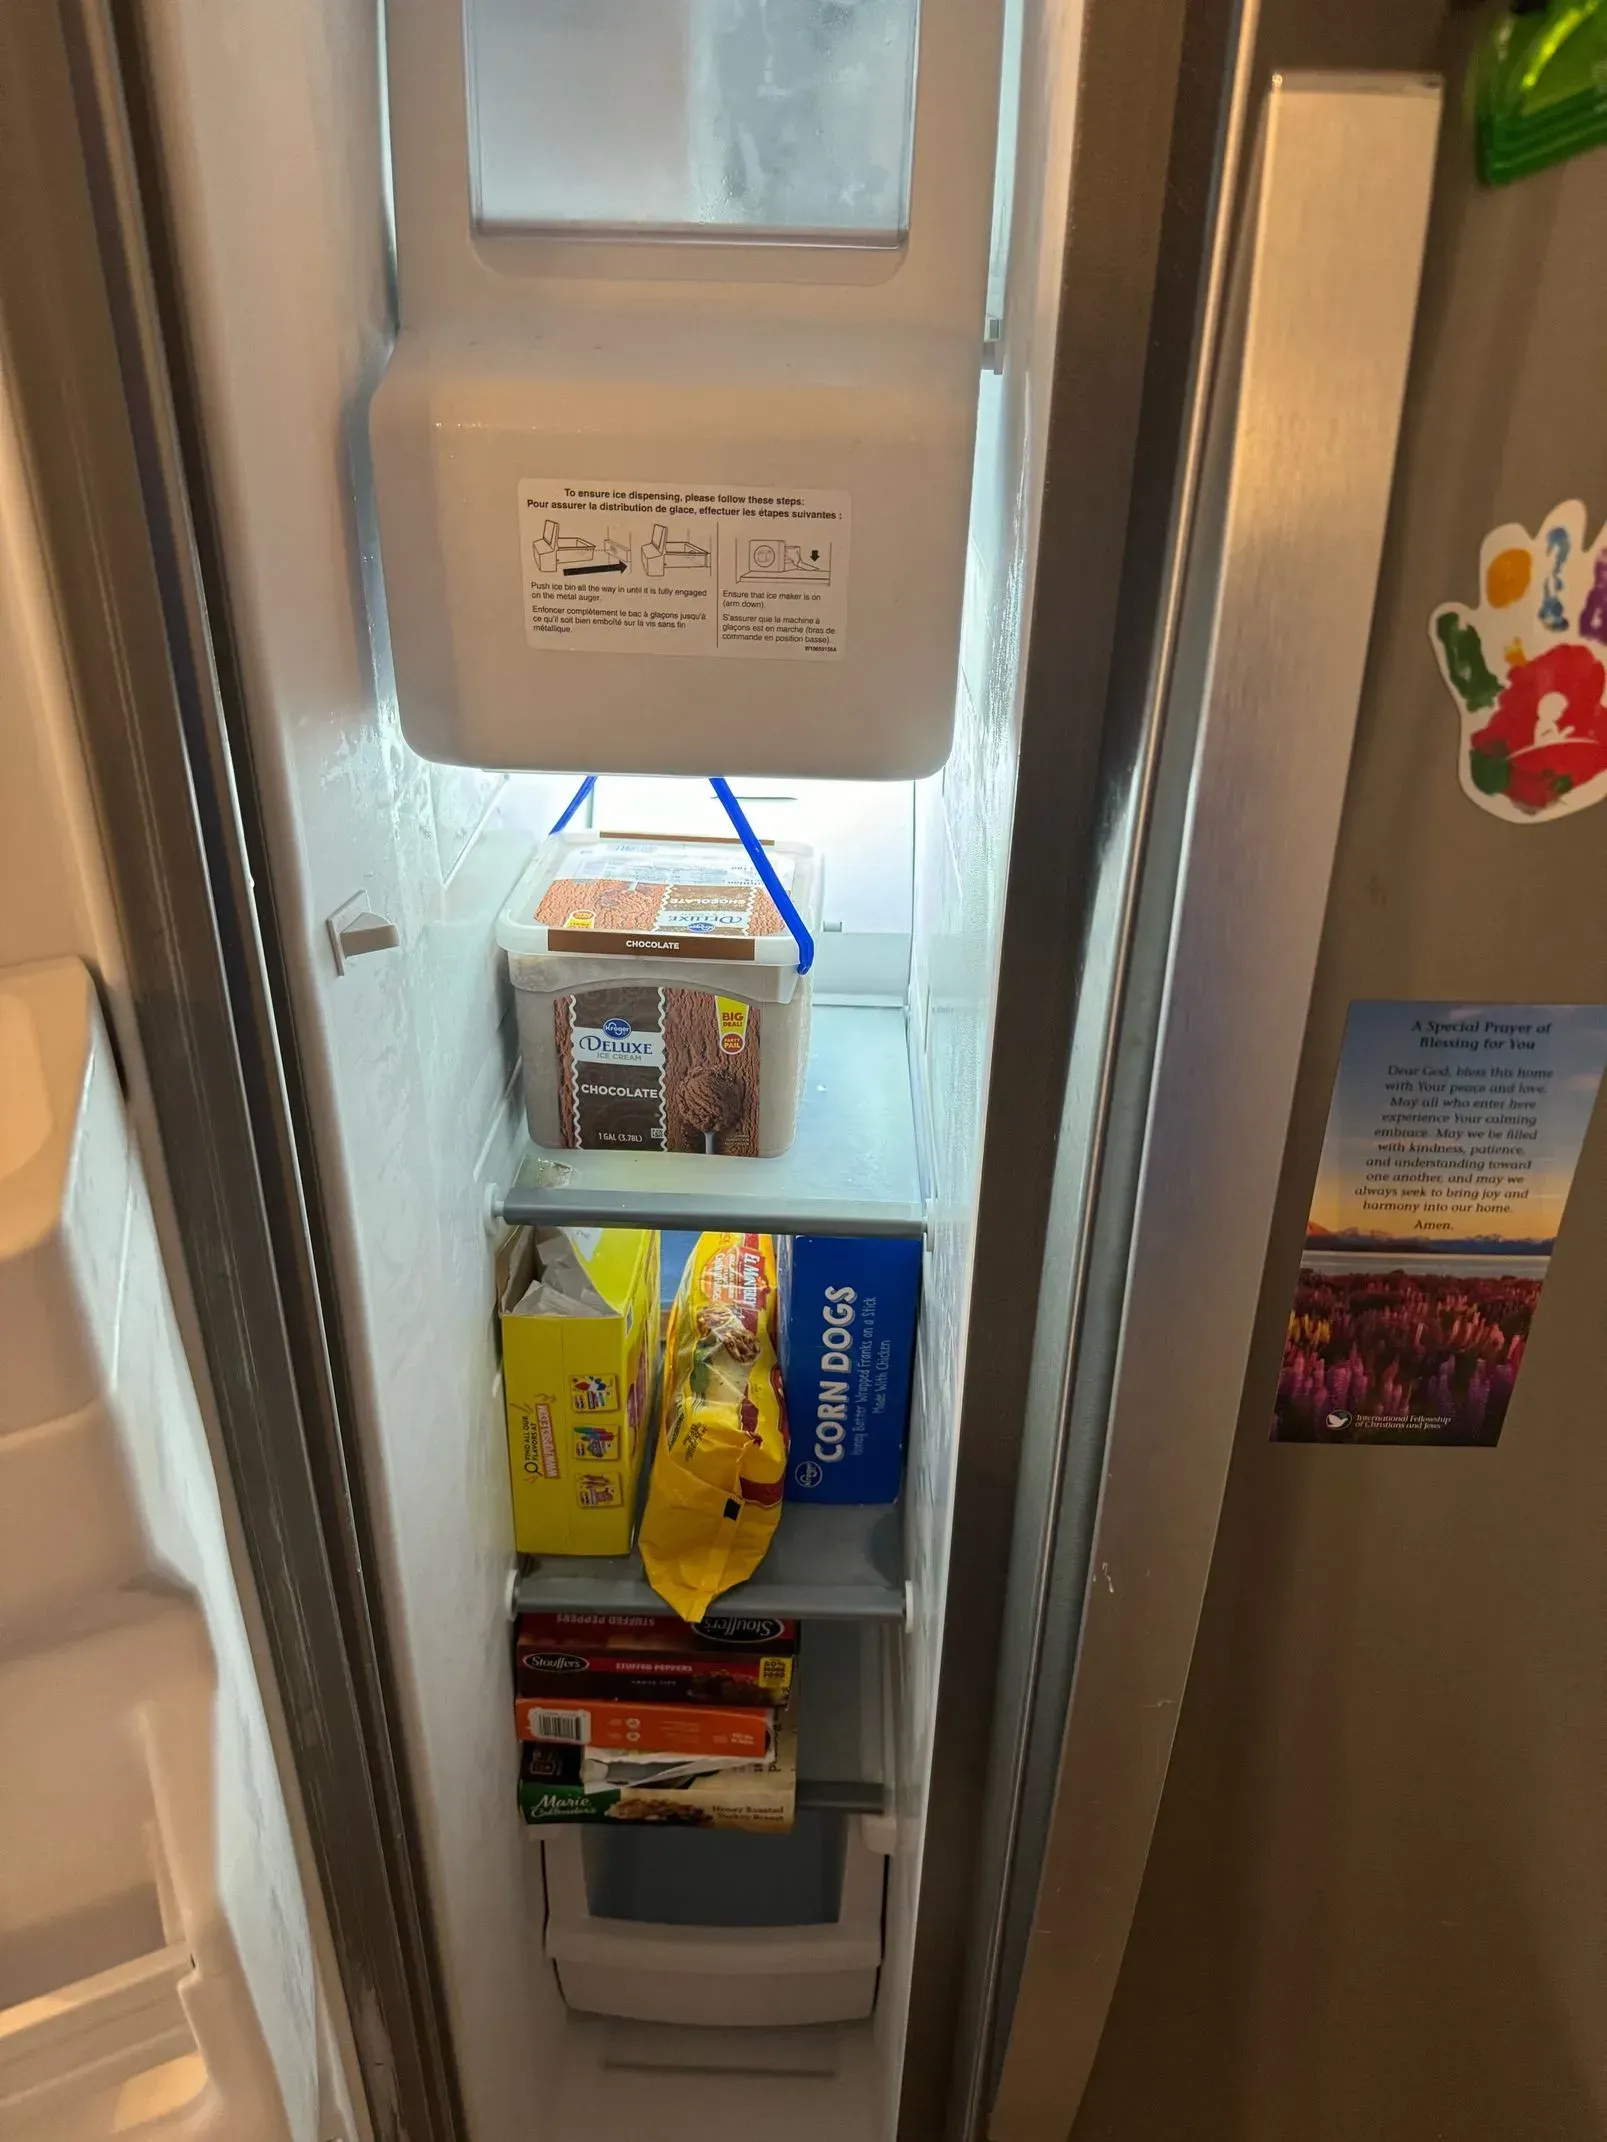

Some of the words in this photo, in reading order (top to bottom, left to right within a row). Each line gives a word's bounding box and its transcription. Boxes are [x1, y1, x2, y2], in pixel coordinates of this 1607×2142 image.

[564, 489, 576, 497] To
[613, 490, 626, 499] ice
[629, 491, 683, 502] dispensing,
[685, 493, 715, 503] please
[718, 495, 746, 503] follow
[776, 498, 804, 506] steps:
[527, 500, 548, 509] Pour
[551, 502, 586, 510] assurer
[589, 502, 597, 510] la
[600, 503, 652, 512] distribution
[656, 504, 667, 513] de
[669, 506, 697, 515] glace,
[700, 508, 739, 516] effectuer
[742, 508, 756, 517] les
[758, 509, 789, 518] étapes
[792, 511, 836, 519] suivantes
[531, 582, 550, 590] Push
[658, 588, 673, 596] fully
[675, 589, 706, 597] engaged
[579, 595, 601, 603] auger.
[723, 600, 740, 608] (arm
[668, 915, 742, 924] DELUXE
[626, 940, 679, 950] CHOCOLATE
[722, 1012, 743, 1021] BIG
[605, 1023, 630, 1037] Kroger
[1412, 1021, 1423, 1031] A
[1426, 1021, 1480, 1034] Special
[1484, 1022, 1531, 1035] Prayer
[1536, 1022, 1553, 1033] of
[579, 1035, 653, 1055] DELUXE
[1420, 1037, 1479, 1051] Blessing
[1483, 1038, 1504, 1049] for
[1509, 1038, 1535, 1050] You
[1388, 1066, 1419, 1076] Dear
[1422, 1066, 1451, 1077] God,
[1456, 1067, 1486, 1077] bless
[1490, 1067, 1513, 1078] this
[1517, 1067, 1553, 1078] home
[581, 1084, 658, 1099] CHOCOLATE
[1385, 1082, 1413, 1092] with
[1418, 1082, 1445, 1092] Your
[1450, 1085, 1486, 1096] peace
[1490, 1084, 1515, 1093] and
[1390, 1097, 1418, 1109] May
[1422, 1098, 1438, 1108] all
[1443, 1099, 1469, 1108] who
[1473, 1099, 1504, 1109] enter
[1509, 1099, 1536, 1109] here
[1382, 1114, 1450, 1125] experience
[1454, 1113, 1481, 1123] Your
[1485, 1114, 1536, 1127] calming
[598, 1133, 602, 1141] 1
[603, 1133, 617, 1141] GAL
[618, 1134, 642, 1142] (3.78L)
[1436, 1128, 1463, 1140] May
[1467, 1131, 1483, 1139] we
[1488, 1129, 1502, 1139] be
[1506, 1129, 1537, 1140] filled
[1378, 1142, 1405, 1152] with
[1409, 1142, 1465, 1154] kindness,
[1366, 1157, 1390, 1167] and
[1394, 1157, 1485, 1171] understanding
[1489, 1160, 1532, 1169] toward
[1393, 1173, 1443, 1184] another,
[1448, 1174, 1472, 1183] and
[1476, 1175, 1504, 1186] may
[1355, 1187, 1397, 1198] always
[1401, 1187, 1426, 1197] seek
[1431, 1188, 1442, 1197] to
[1446, 1187, 1478, 1200] bring
[1482, 1188, 1500, 1200] joy
[1504, 1188, 1529, 1198] and
[1363, 1201, 1419, 1213] harmony
[1423, 1202, 1448, 1212] into
[1452, 1204, 1472, 1212] our
[1476, 1202, 1513, 1213] home.
[1414, 1219, 1454, 1230] Amen.
[744, 1253, 760, 1263] EL
[862, 1296, 876, 1317] Stick
[821, 1285, 857, 1373] DOGS
[861, 1327, 874, 1338] on
[857, 1340, 873, 1367] Franks
[876, 1340, 891, 1370] Chicken
[854, 1369, 872, 1402] Wrapped
[875, 1372, 888, 1391] With
[814, 1380, 848, 1462] CORN
[1356, 1414, 1408, 1422] International
[1410, 1415, 1451, 1425] Fellowship
[531, 1423, 536, 1431] AT
[800, 1462, 817, 1486] Kroger
[556, 1613, 605, 1624] PEPPERS
[608, 1616, 655, 1626] STUFFED
[536, 1794, 592, 1807] Marie
